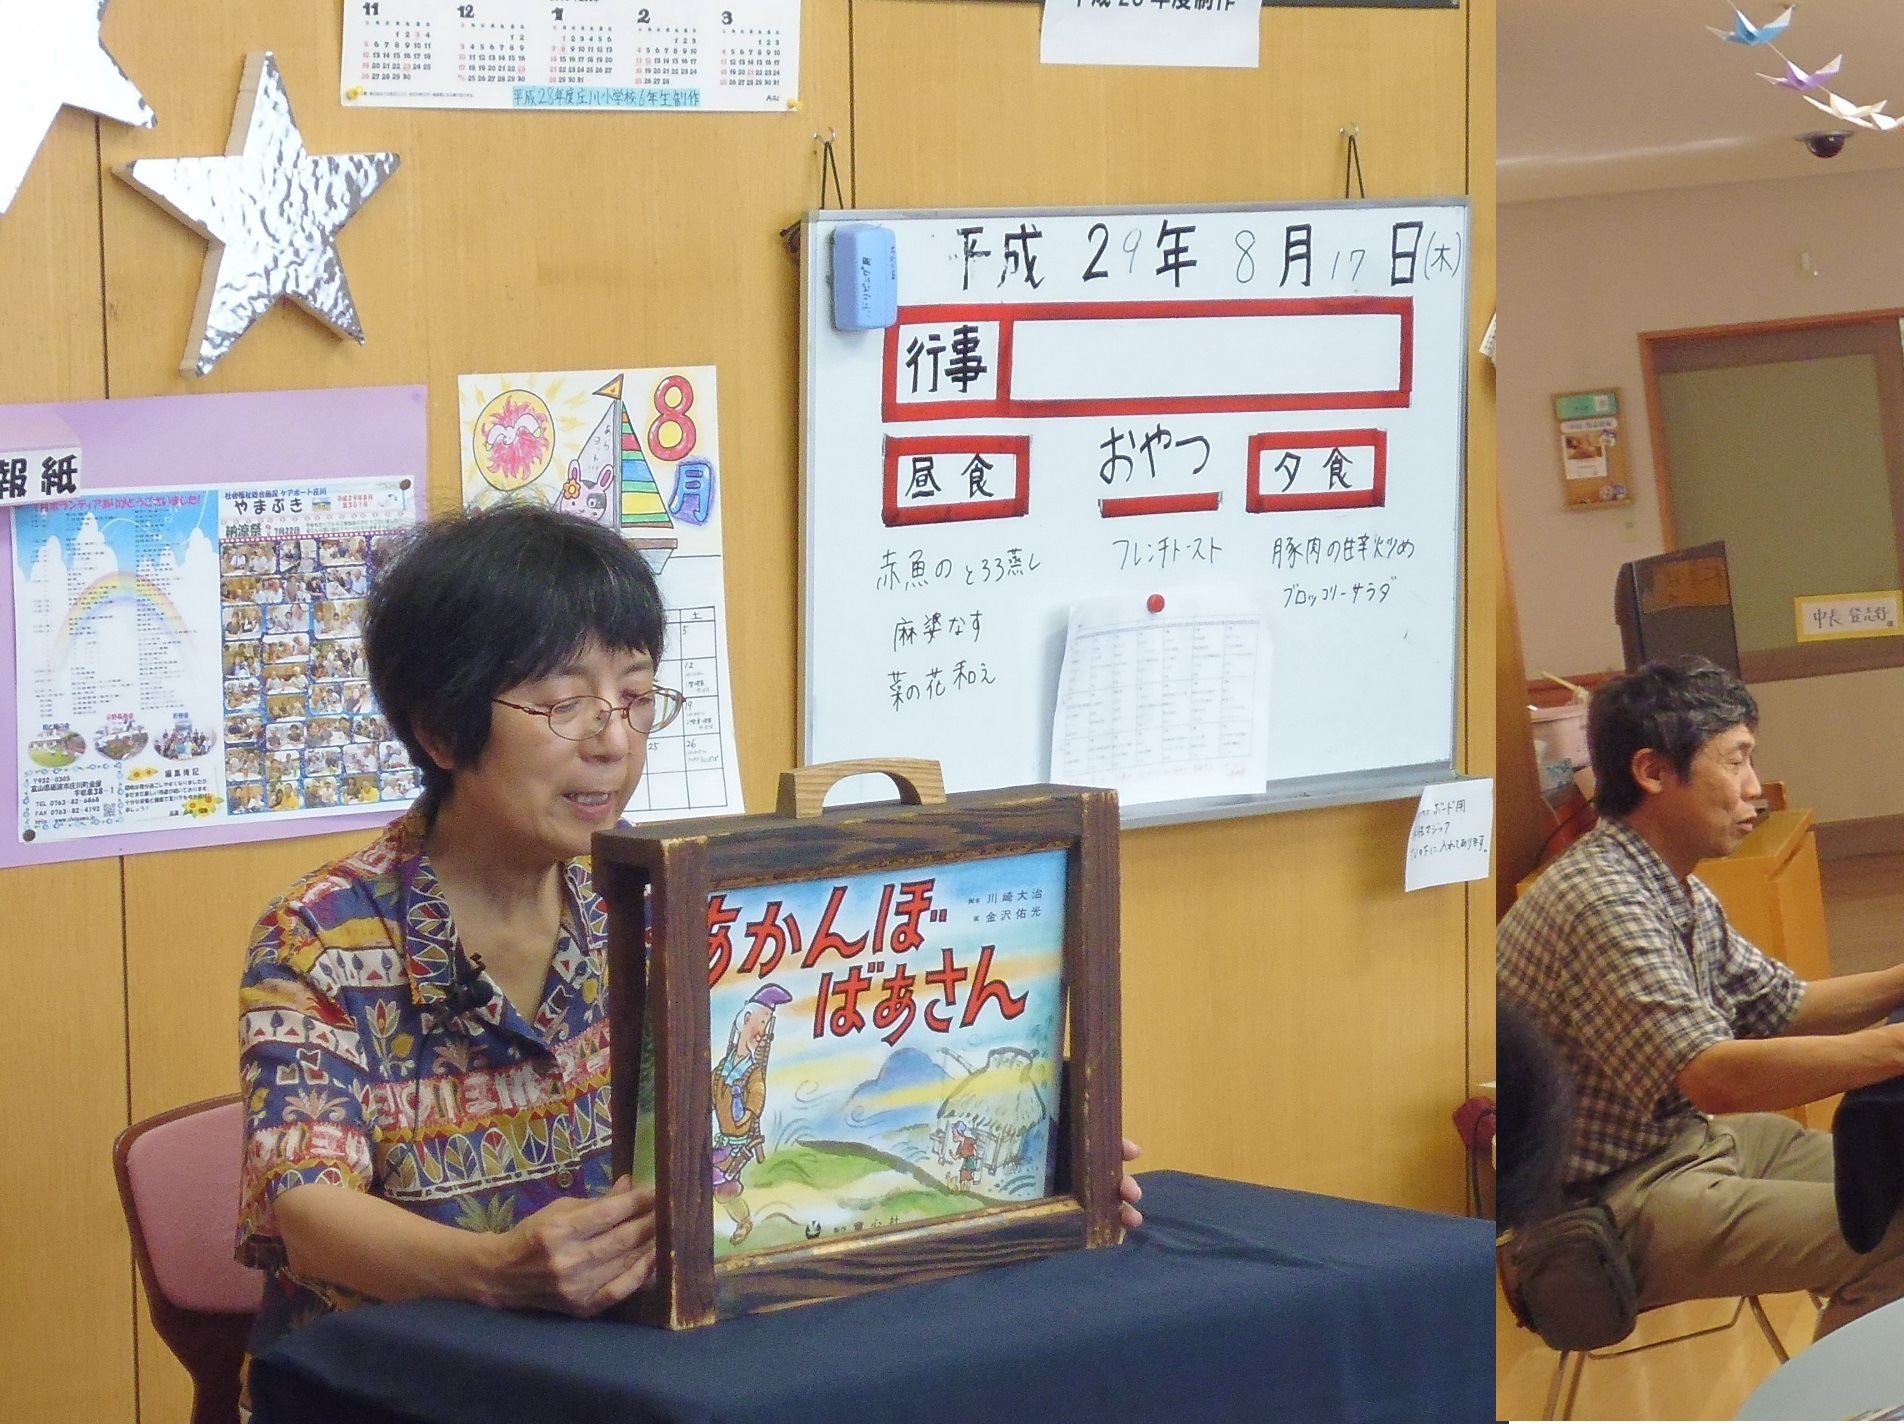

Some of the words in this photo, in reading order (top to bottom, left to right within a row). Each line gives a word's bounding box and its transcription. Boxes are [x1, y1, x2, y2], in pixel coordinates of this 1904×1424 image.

[363, 2, 379, 16] 11
[457, 4, 475, 19] 12
[551, 7, 564, 21] 1
[637, 8, 650, 24] 2
[721, 11, 733, 25] 3
[956, 223, 1043, 290] 平成
[905, 325, 988, 394] 行事
[648, 375, 696, 461] 8
[905, 453, 995, 500] 昼食
[1099, 425, 1210, 486] おやつ
[1274, 449, 1354, 492] 夕食
[235, 498, 303, 515] やまぶき
[669, 463, 711, 522] 月
[986, 888, 1043, 904] 川崎大治
[986, 906, 1042, 923] 金沢佑光
[708, 878, 948, 987] あかんぼ
[812, 946, 1030, 1046] ばあさん
